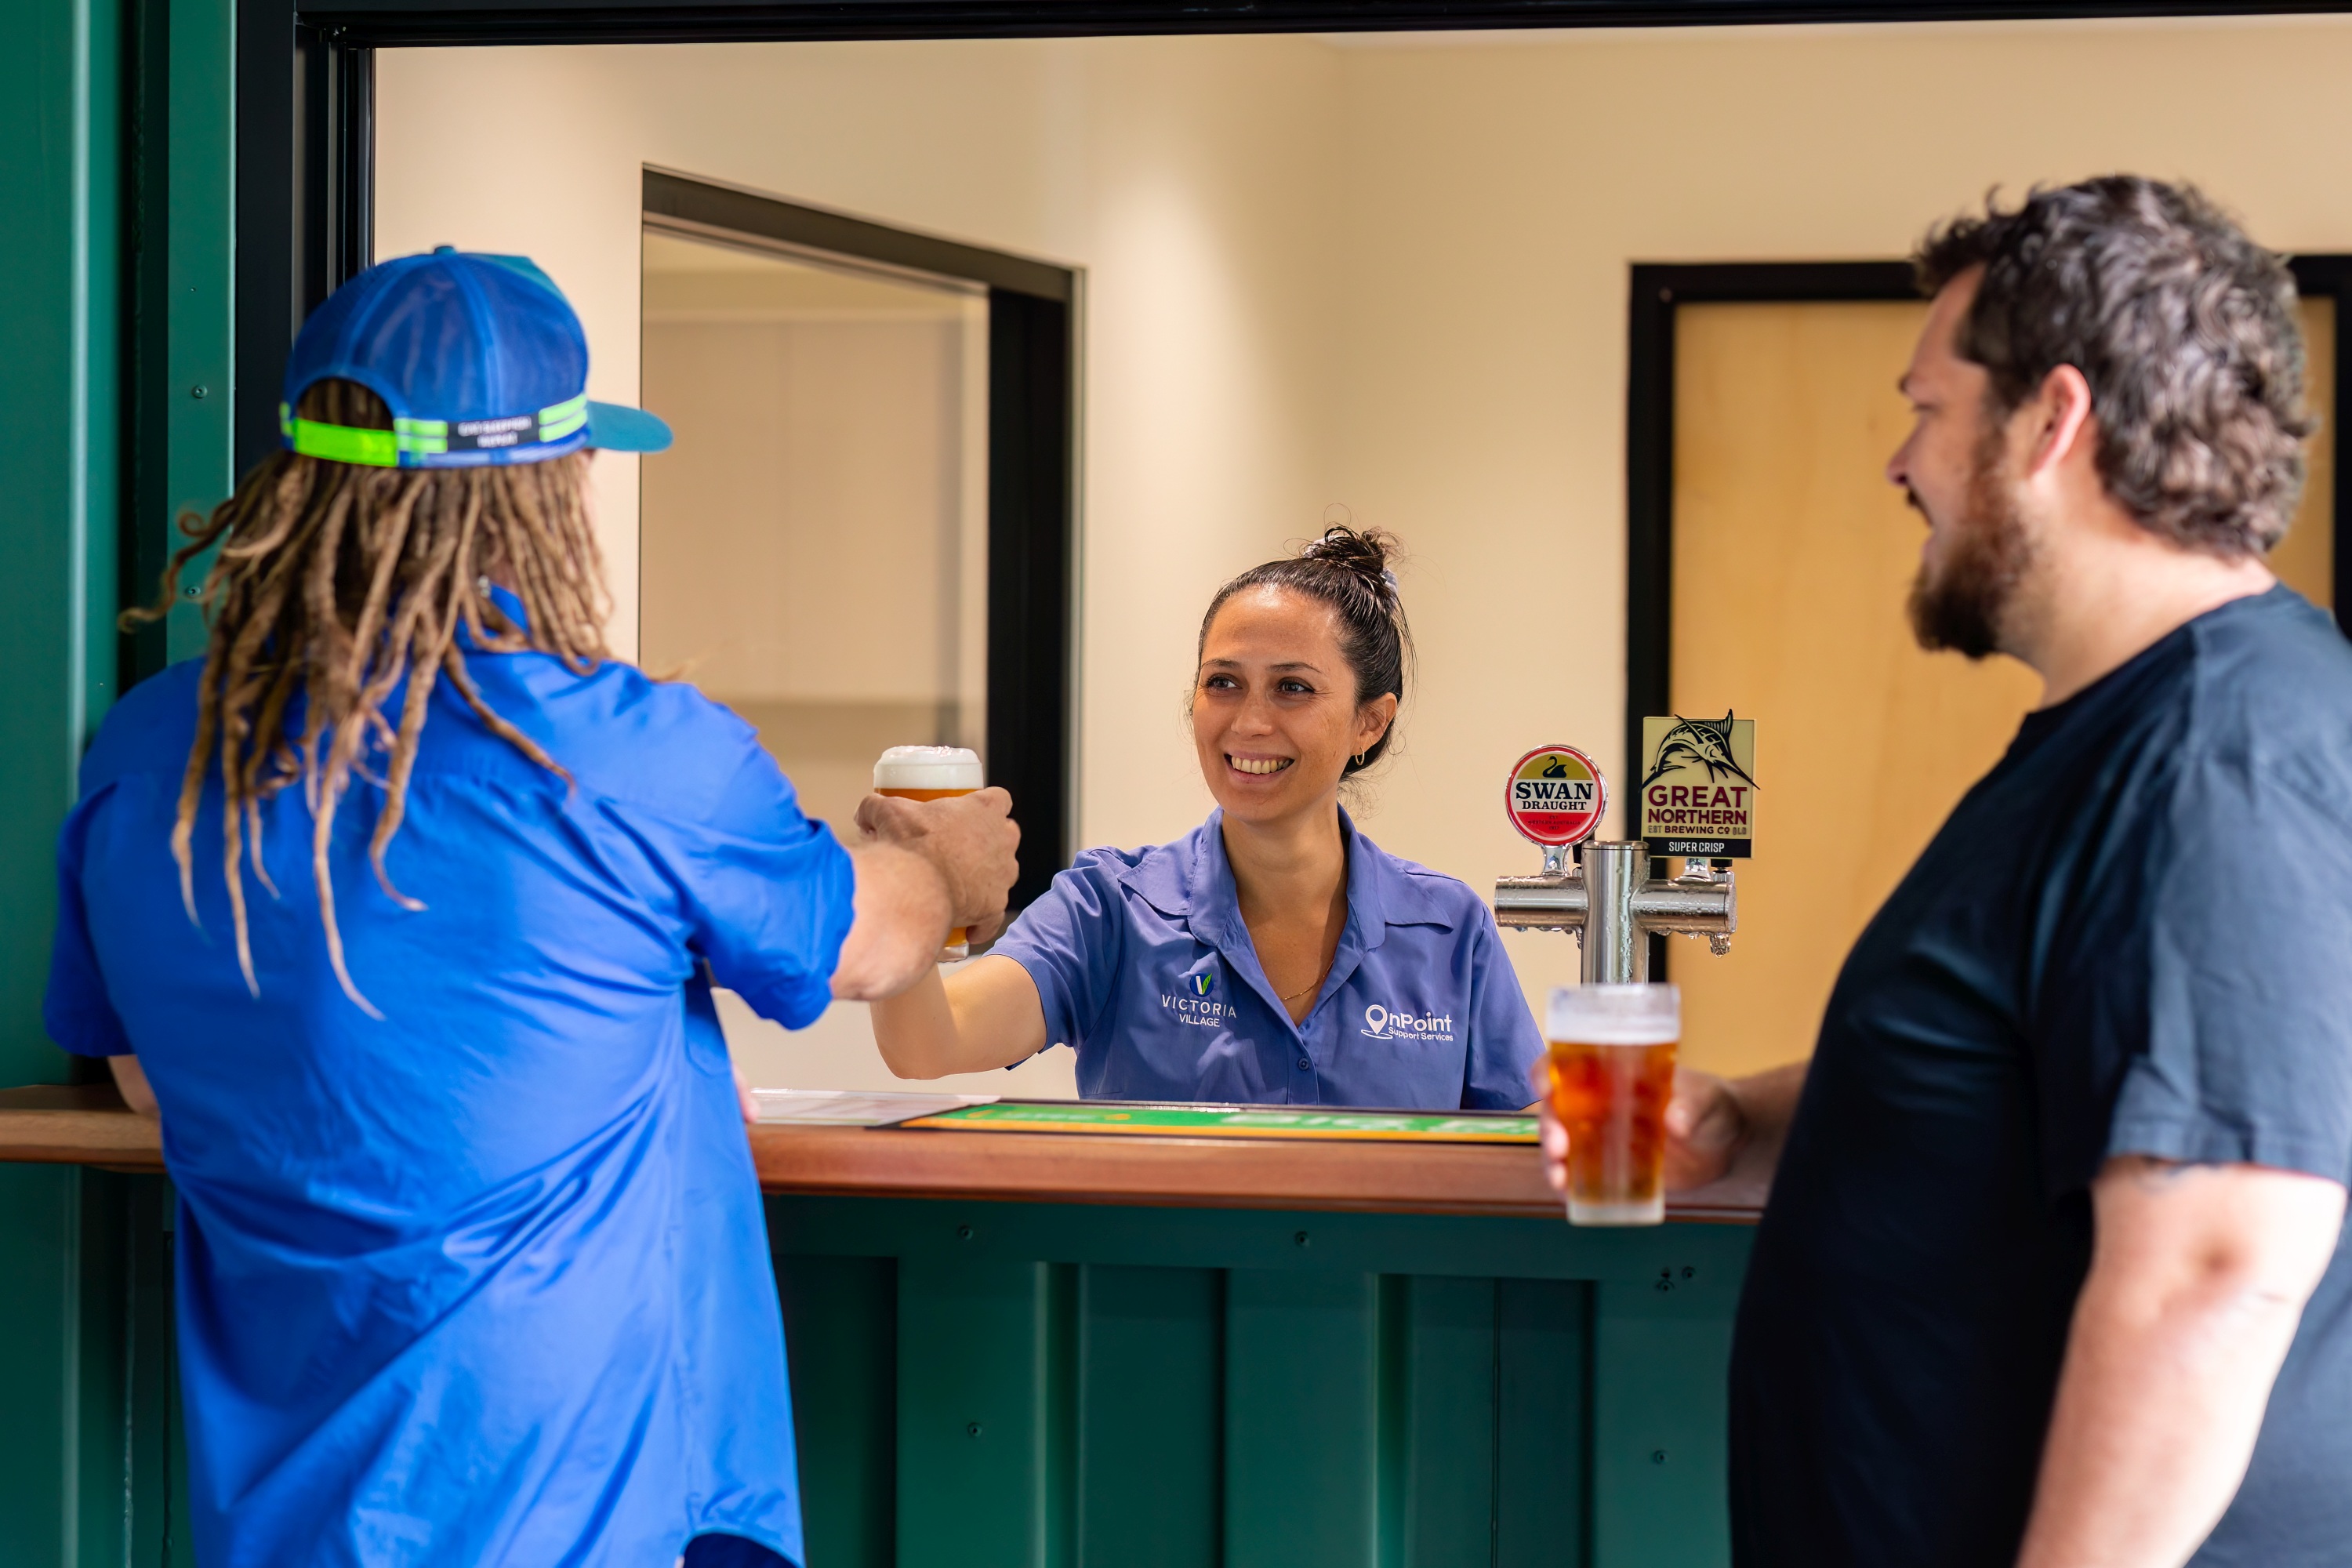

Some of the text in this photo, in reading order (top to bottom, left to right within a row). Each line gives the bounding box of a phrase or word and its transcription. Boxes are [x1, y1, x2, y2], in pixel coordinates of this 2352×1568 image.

[1515, 782, 1594, 800] SWAN
[1648, 785, 1748, 808] GREAT
[1522, 800, 1587, 810] DRAUGHT
[1648, 808, 1747, 825] NORTHERN
[1648, 825, 1663, 833] EST
[1664, 826, 1714, 834] BREWING
[1668, 841, 1725, 853] SUPER CRISP
[1162, 994, 1237, 1018] VICTORIA
[1179, 1013, 1220, 1028] VILLAGE
[1388, 1026, 1454, 1041] Support Services
